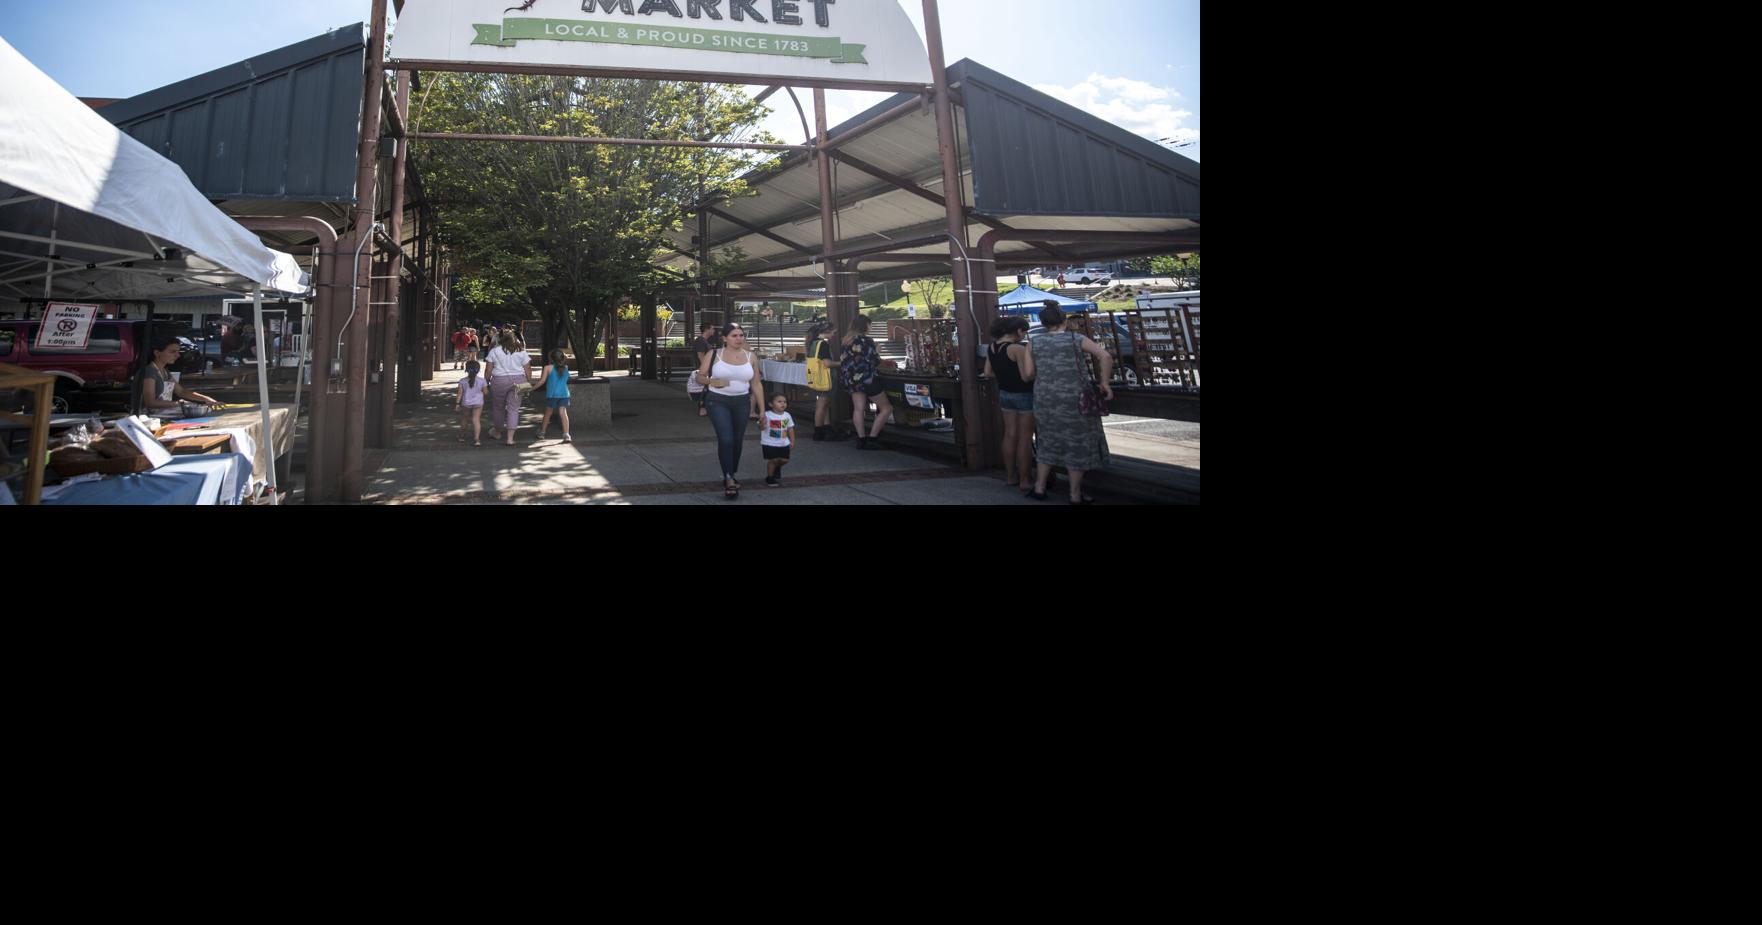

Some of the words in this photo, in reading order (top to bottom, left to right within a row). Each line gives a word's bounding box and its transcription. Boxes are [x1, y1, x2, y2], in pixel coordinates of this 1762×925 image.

[580, 0, 836, 27] MARKET
[545, 24, 609, 37] LOCAL
[617, 27, 629, 39] &
[636, 29, 705, 44] PROUD
[712, 35, 768, 49] SINCE
[774, 40, 809, 52] 1783
